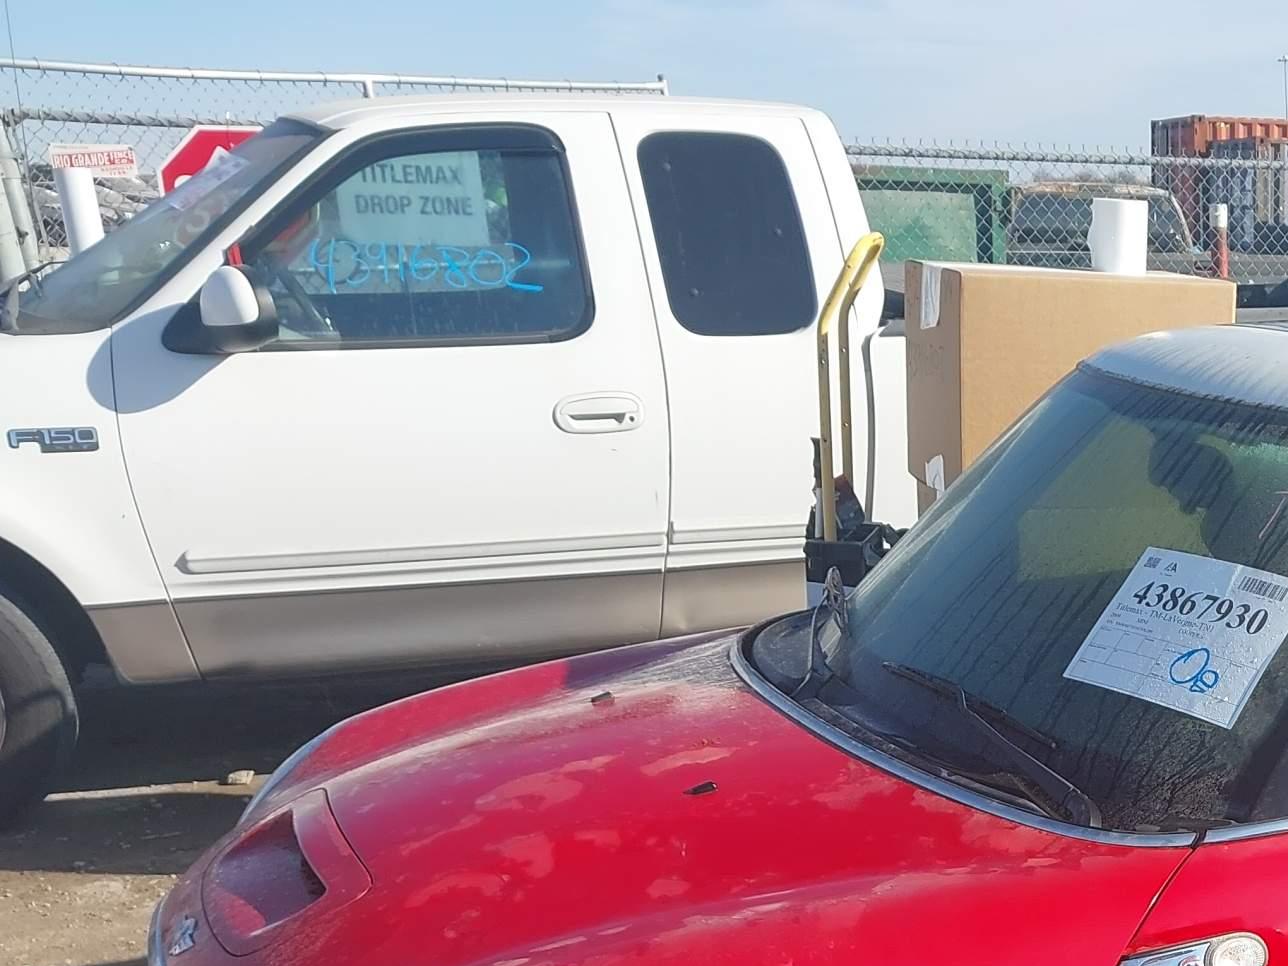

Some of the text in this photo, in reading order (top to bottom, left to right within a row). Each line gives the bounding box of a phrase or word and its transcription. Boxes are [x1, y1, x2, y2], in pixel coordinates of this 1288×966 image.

[54, 154, 71, 168] RIO
[71, 151, 110, 167] GRANDE
[360, 163, 462, 185] TITLEMAX
[354, 194, 473, 216] DROP ZONE
[309, 238, 544, 294] 43916802
[1133, 582, 1268, 634] 43867930
